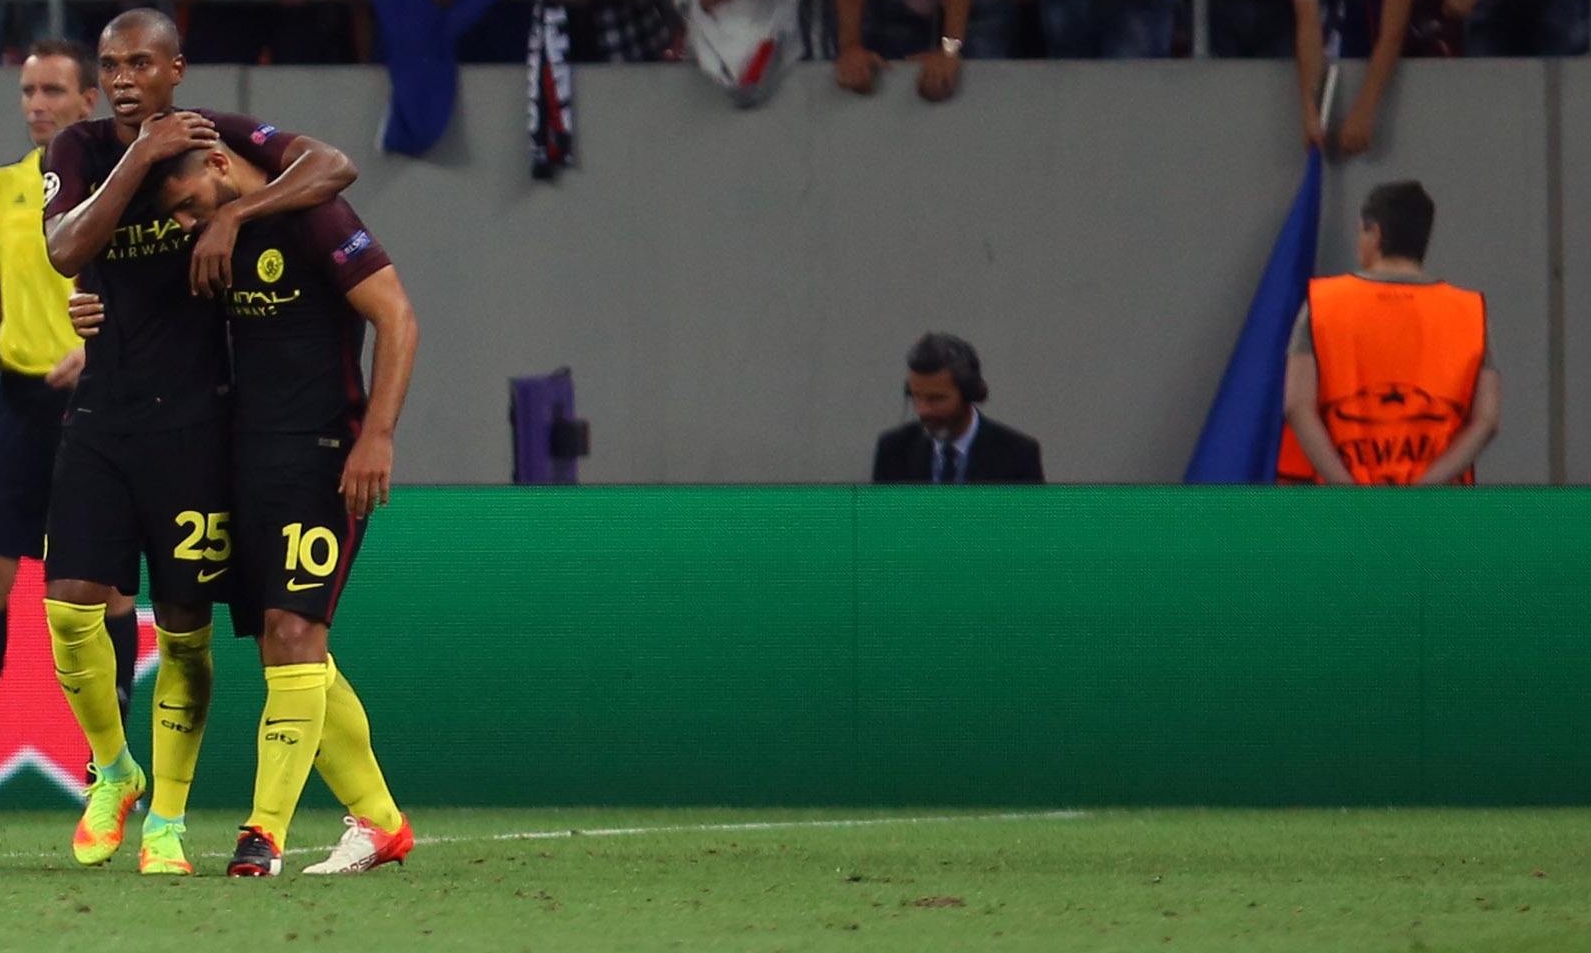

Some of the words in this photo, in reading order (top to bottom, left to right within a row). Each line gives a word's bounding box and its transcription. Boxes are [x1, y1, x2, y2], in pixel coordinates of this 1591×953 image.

[111, 217, 182, 246] TIHA
[174, 511, 231, 561] 25
[282, 523, 339, 577] 10
